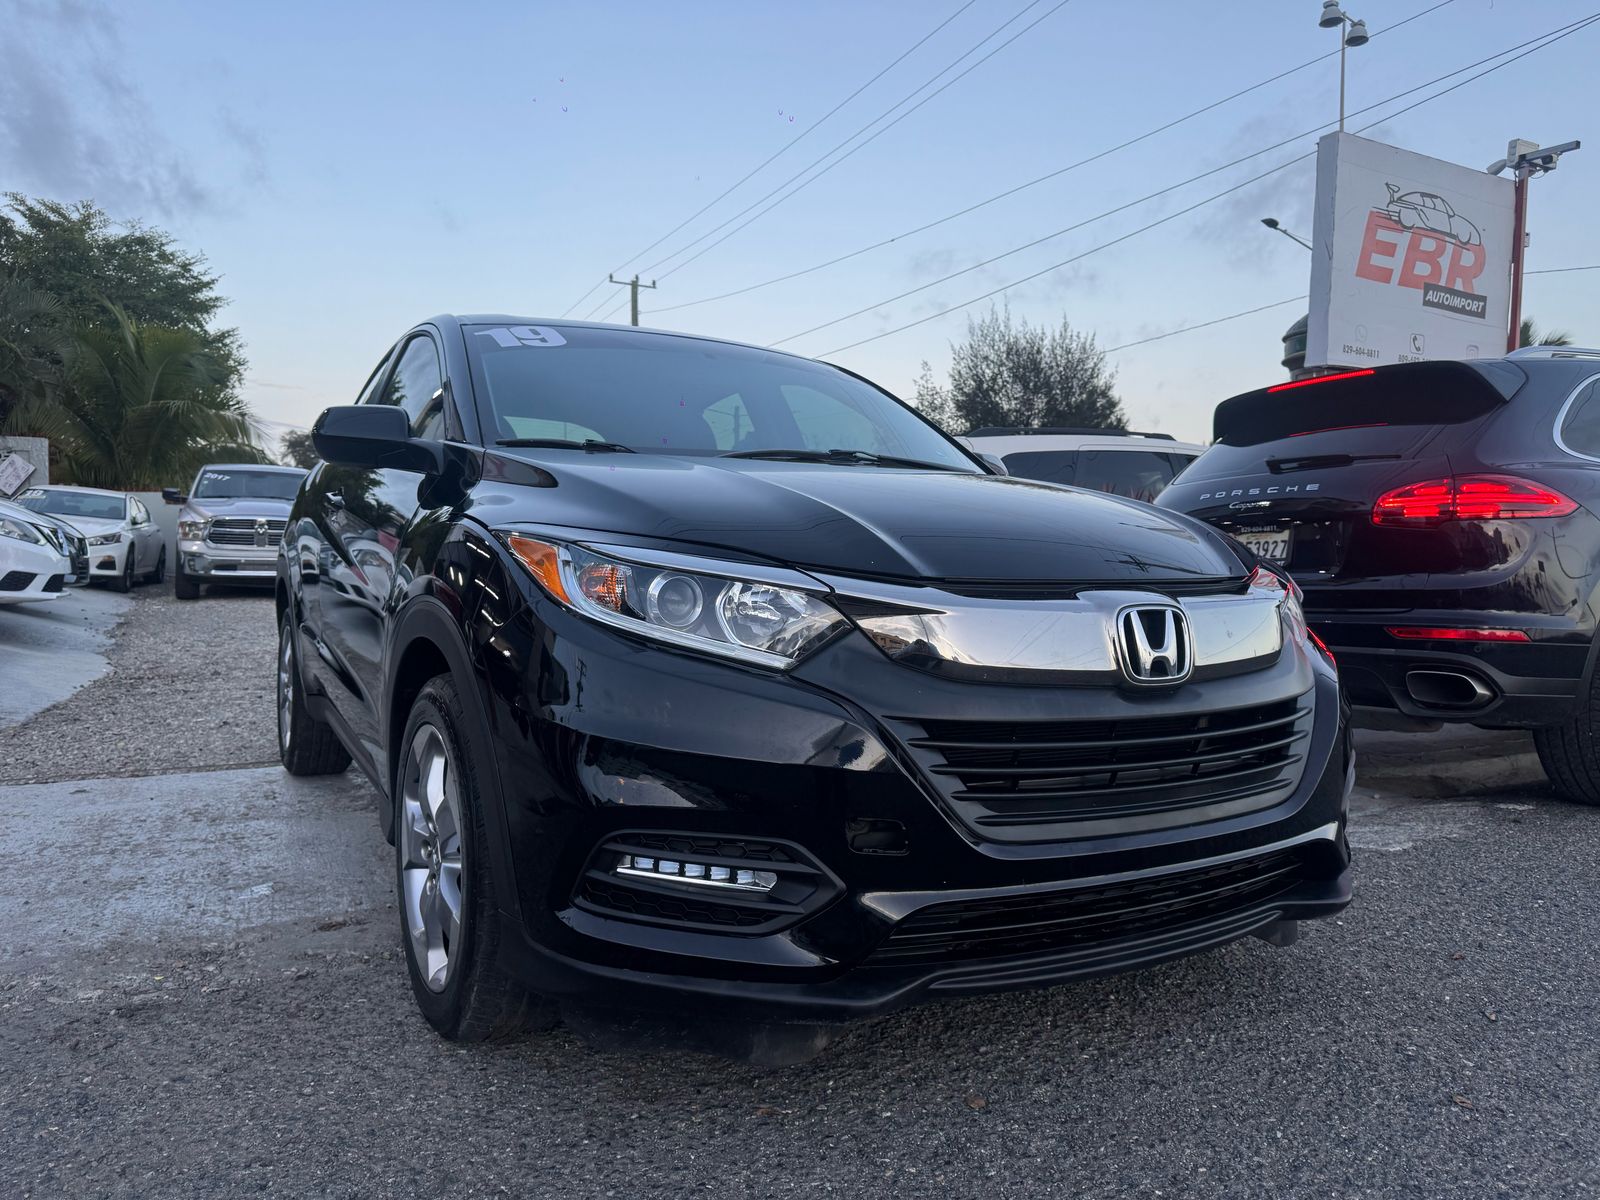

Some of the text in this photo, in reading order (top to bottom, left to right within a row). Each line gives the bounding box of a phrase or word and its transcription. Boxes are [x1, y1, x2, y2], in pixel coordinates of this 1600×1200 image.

[1356, 210, 1486, 294] EBR
[1425, 289, 1485, 313] AUTOIMPORT
[474, 325, 567, 348] 19
[204, 472, 231, 481] 2017
[1200, 483, 1319, 500] PORSCHE
